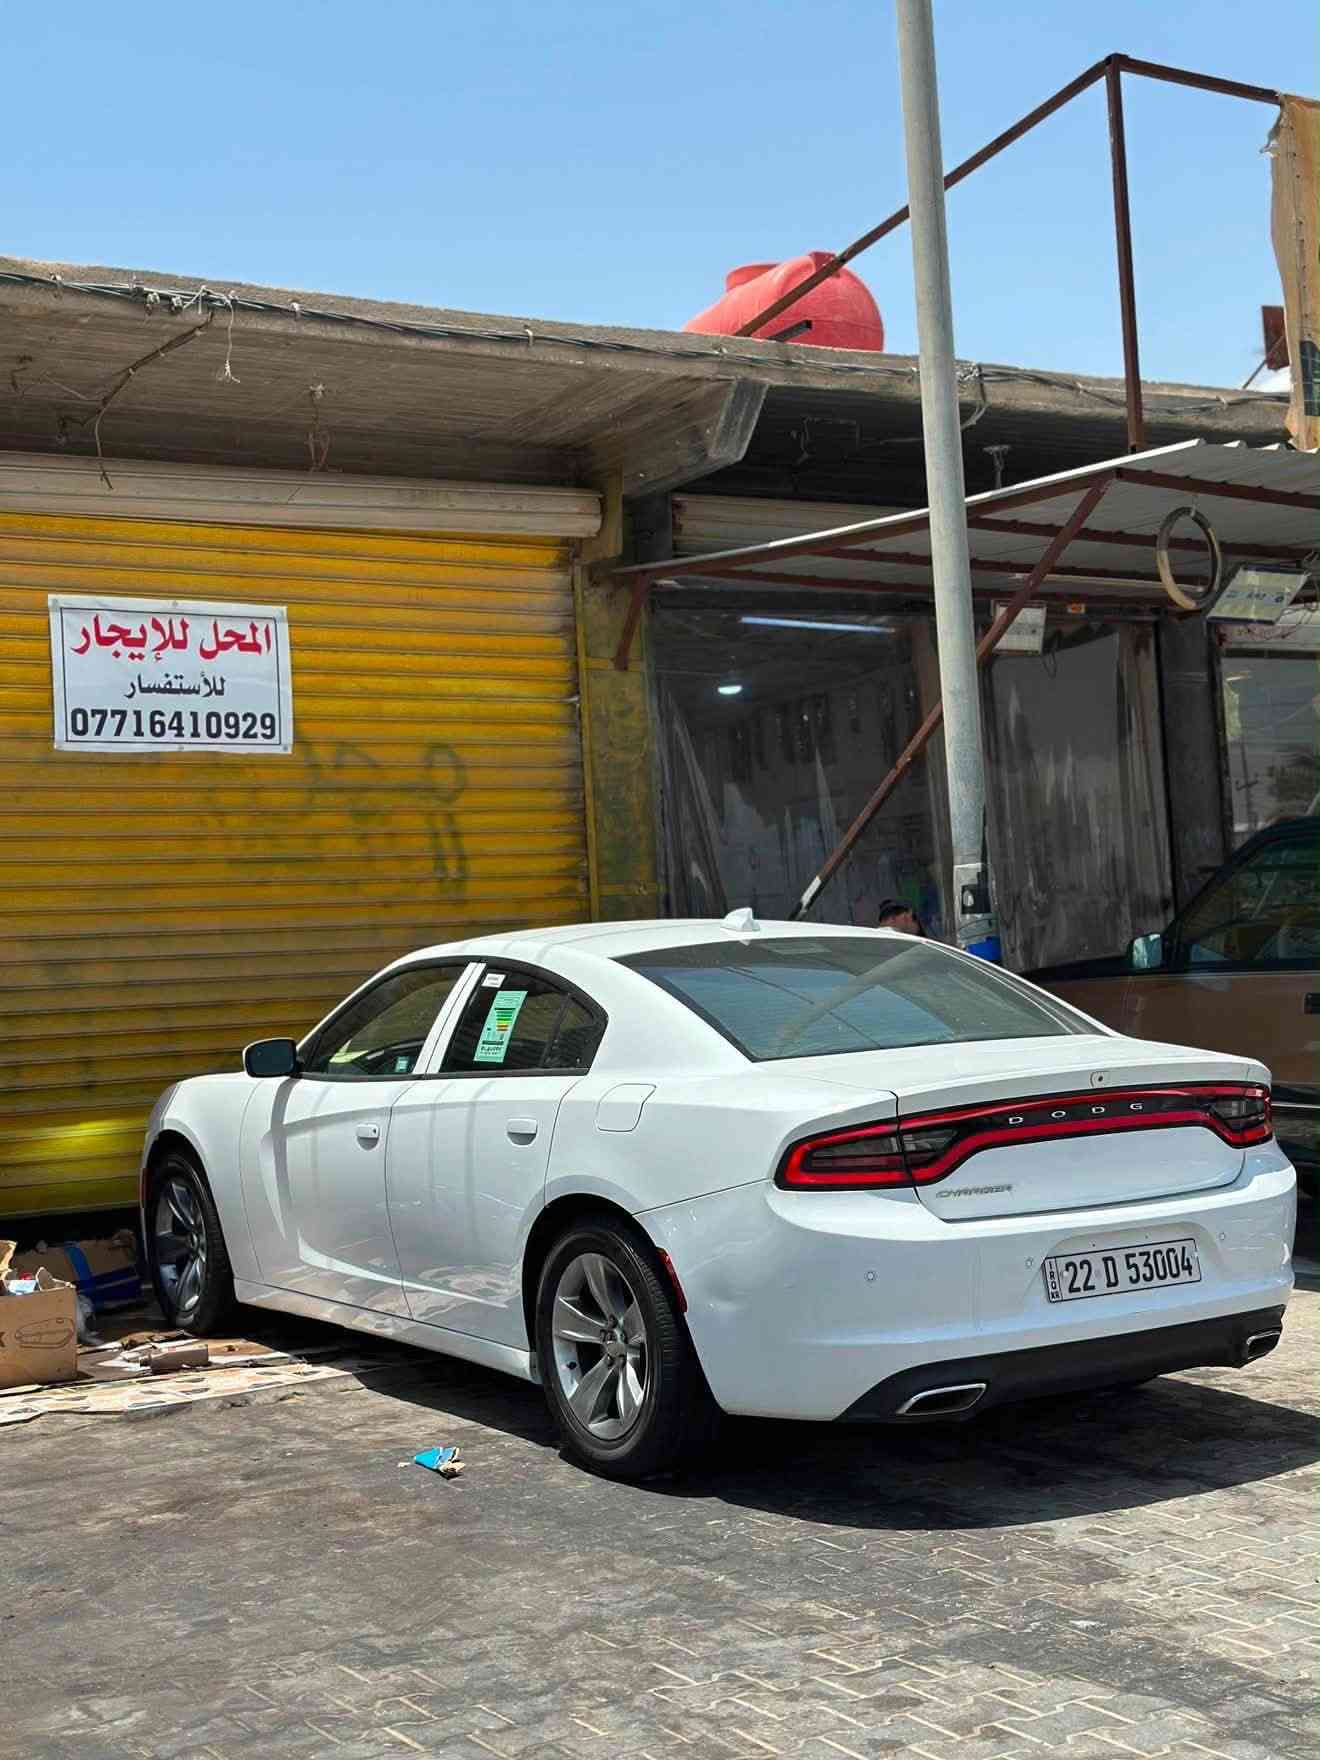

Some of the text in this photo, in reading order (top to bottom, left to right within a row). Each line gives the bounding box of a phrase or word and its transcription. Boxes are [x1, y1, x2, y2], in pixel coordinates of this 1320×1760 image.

[71, 613, 272, 662] المحل للإيجار
[123, 671, 226, 699] للأستفسار
[70, 707, 277, 740] 07716410929
[1064, 1245, 1194, 1294] 22 D 53004
